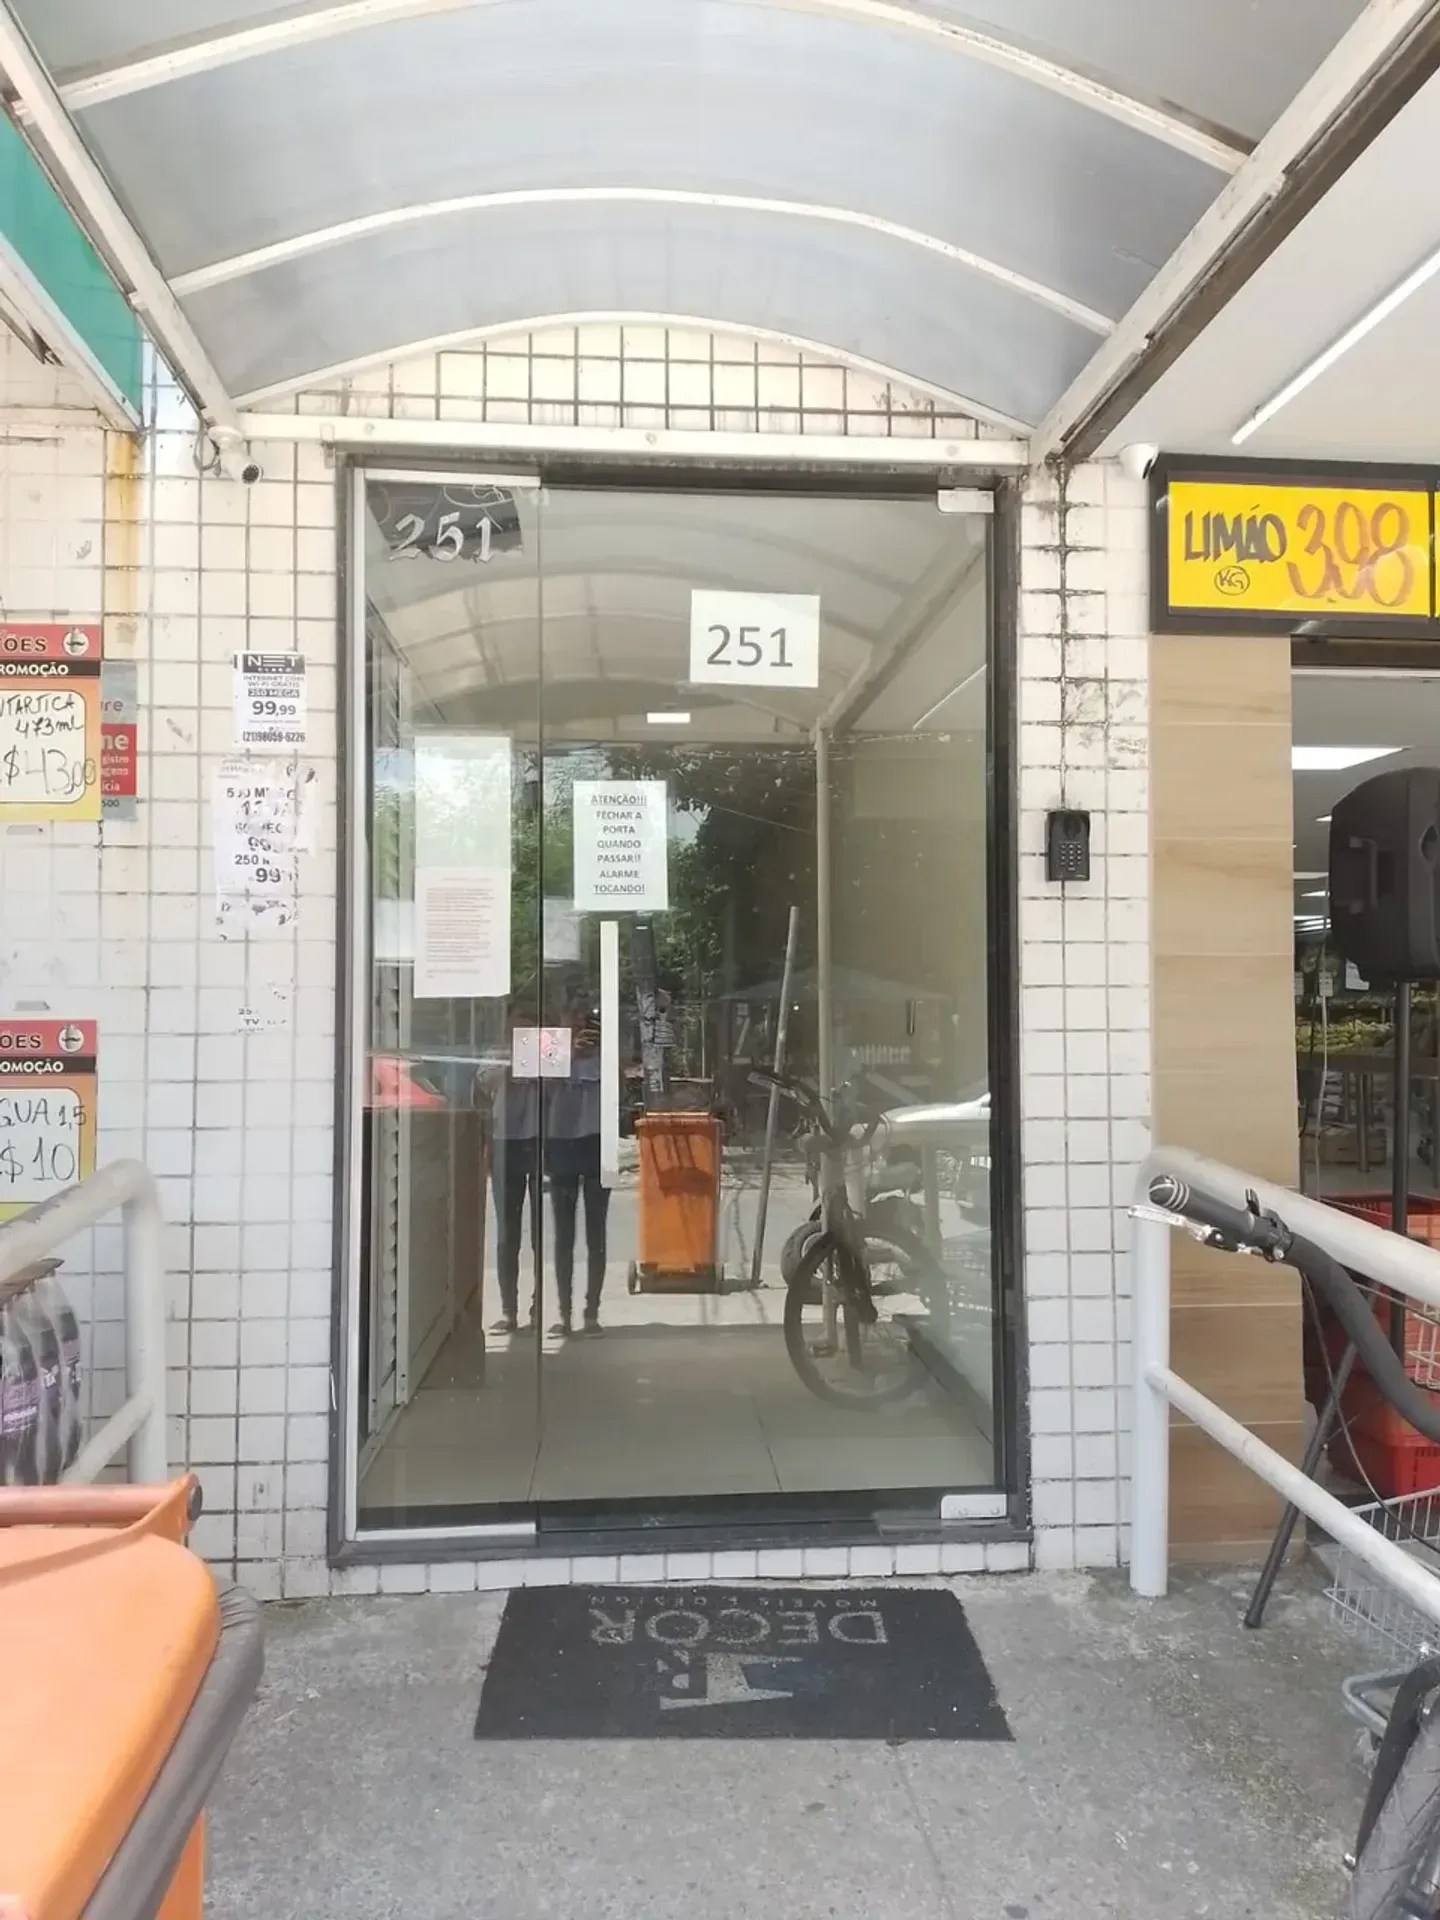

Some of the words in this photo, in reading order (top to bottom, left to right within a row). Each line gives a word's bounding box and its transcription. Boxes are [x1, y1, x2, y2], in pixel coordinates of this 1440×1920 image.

[388, 511, 494, 564] 251
[1218, 568, 1245, 589] KG
[0, 633, 47, 652] ÕES
[706, 624, 794, 668] 251
[252, 700, 297, 716] 99,99
[596, 811, 633, 820] FECHAR
[634, 811, 642, 820] A
[602, 825, 636, 834] PORTA
[596, 840, 642, 849] QUANDO
[599, 869, 640, 879] ALARME
[593, 884, 646, 893] TOCANDO!
